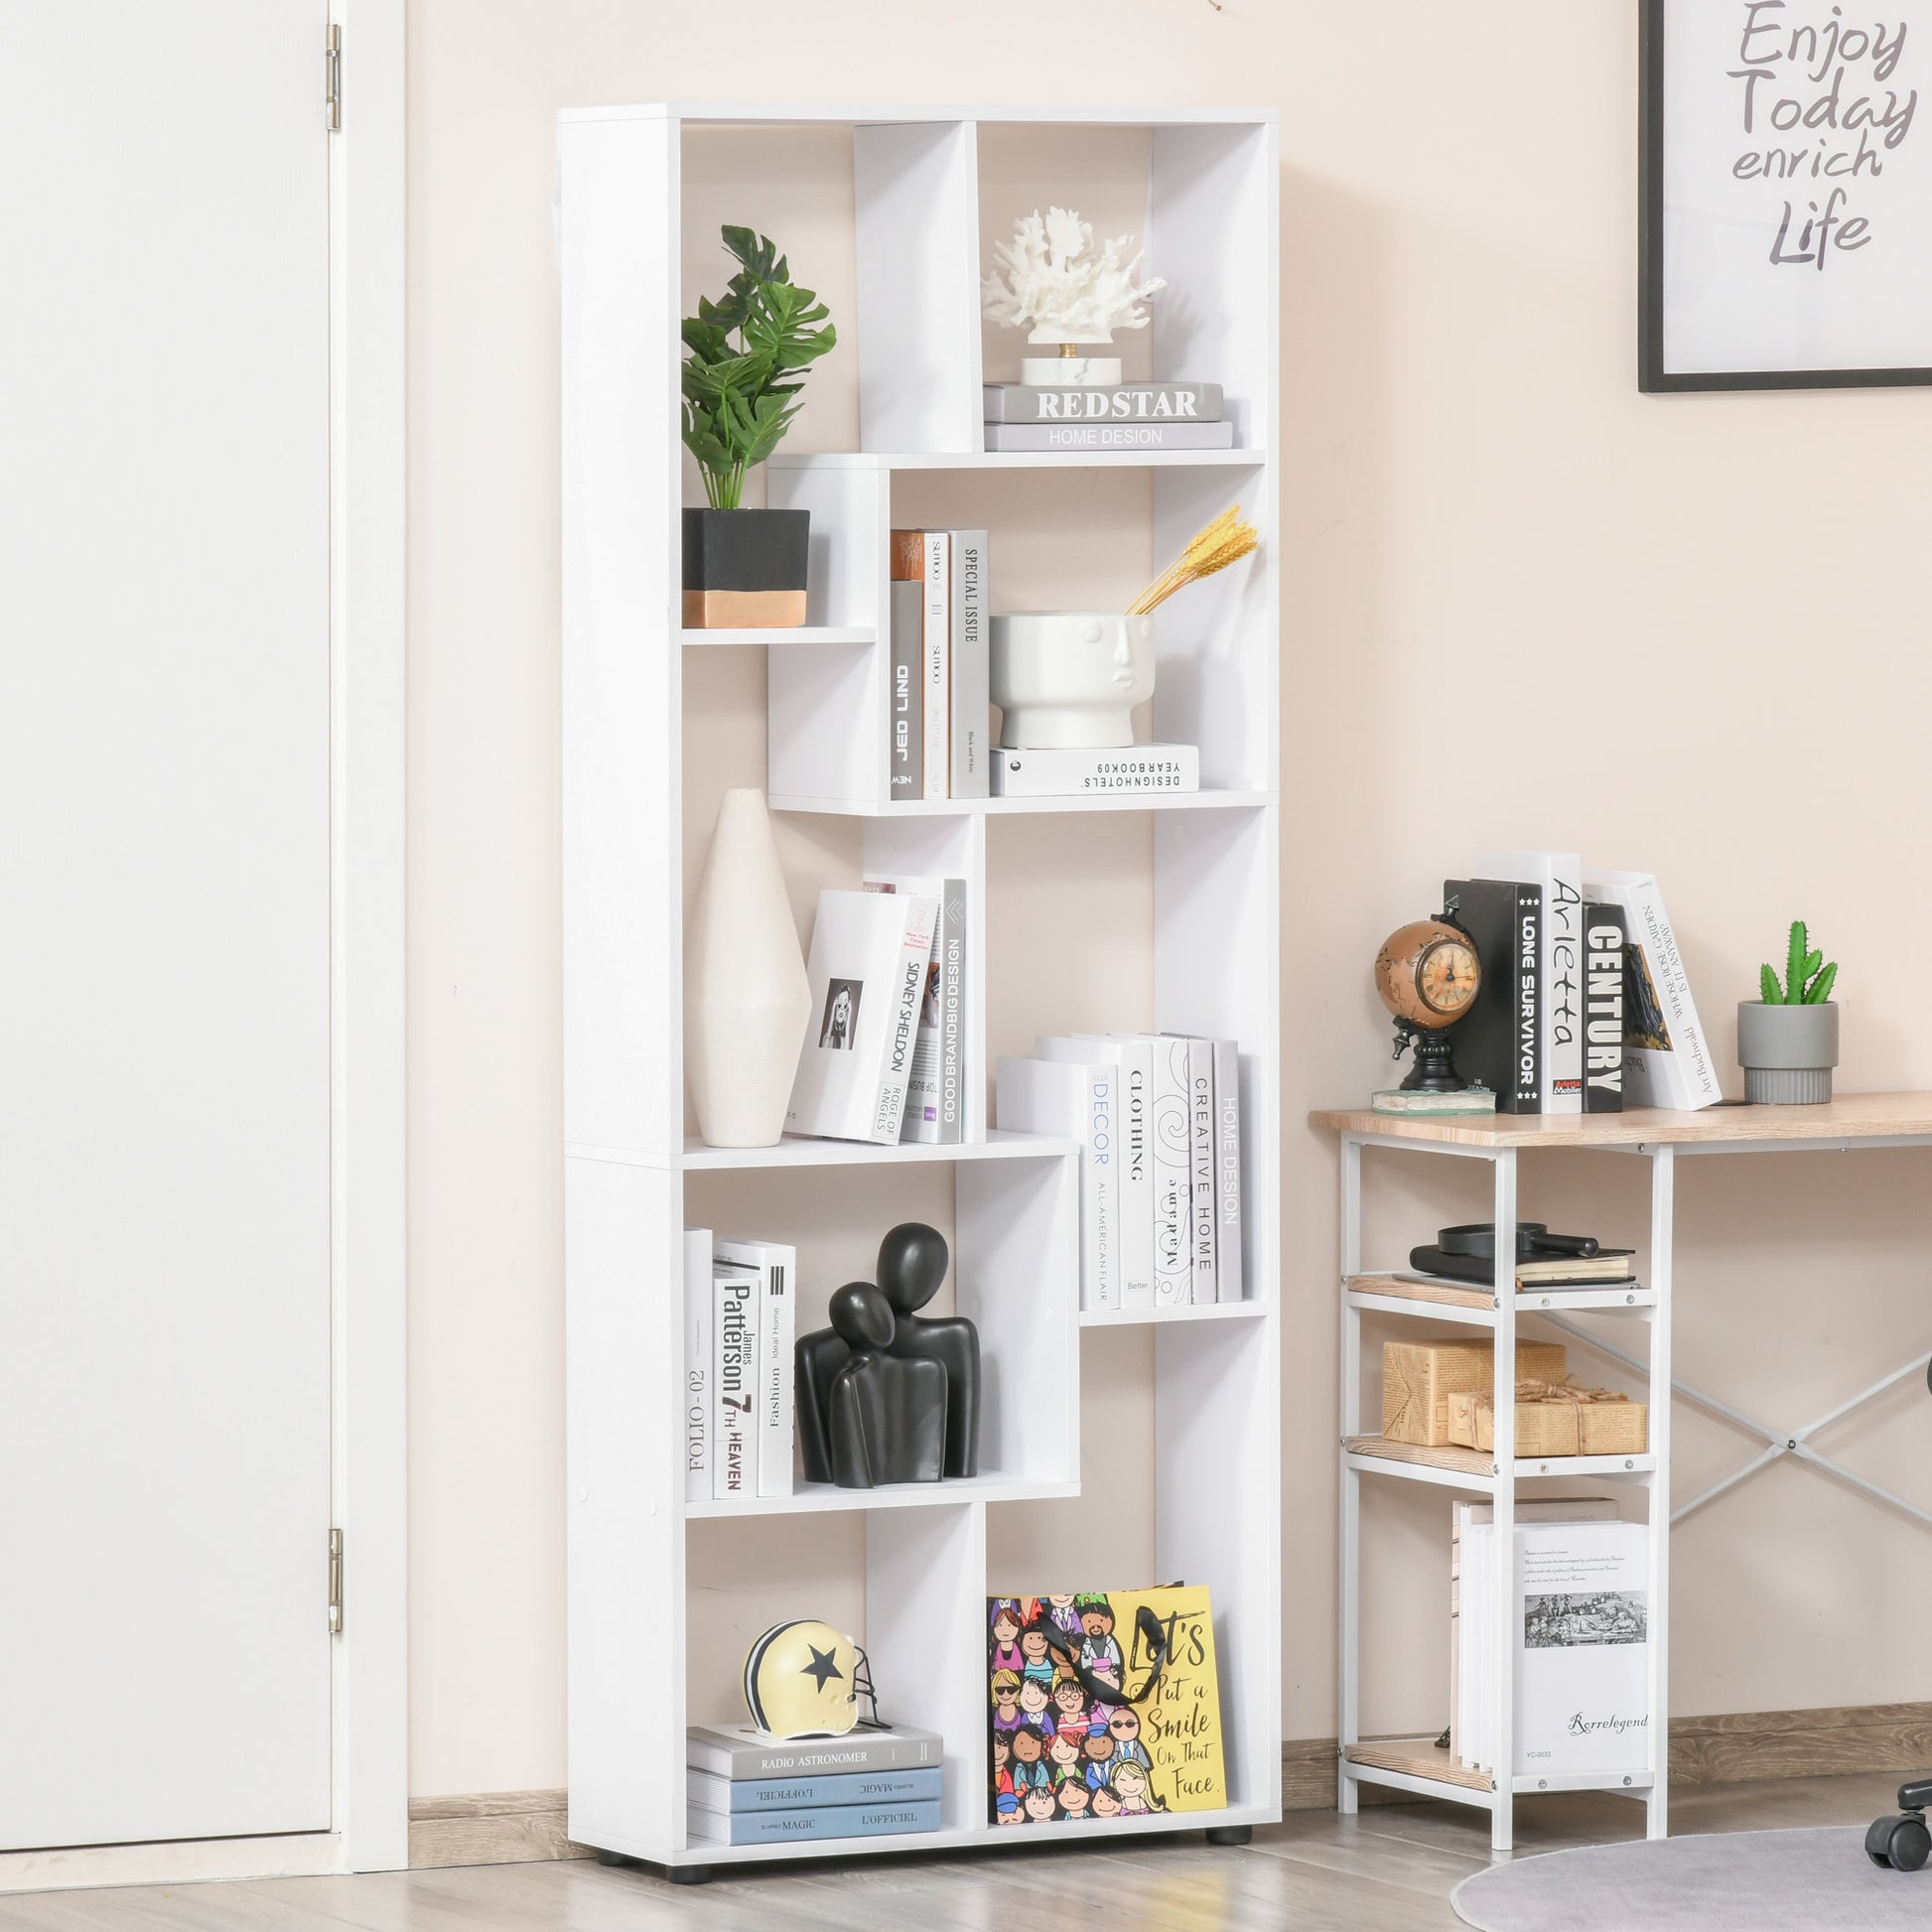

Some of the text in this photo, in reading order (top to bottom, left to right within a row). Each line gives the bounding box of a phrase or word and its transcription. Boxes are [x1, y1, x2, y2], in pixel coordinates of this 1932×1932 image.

[1740, 0, 1907, 82] Enjoy
[1725, 67, 1917, 150] Today
[1732, 128, 1882, 180] enrich
[1769, 187, 1871, 271] Life
[1036, 391, 1198, 419] REDSTAR
[1049, 428, 1163, 445] HOME DESIGN
[965, 548, 978, 642] SPECIAL ISSUE
[897, 665, 908, 761] JED LIND
[891, 775, 912, 784] NEW
[1642, 904, 1663, 949] GARDEN
[947, 938, 960, 995] DESIGN
[1657, 952, 1673, 978] ROSE
[1677, 982, 1688, 993] IS
[891, 961, 919, 1072] SIDNEY SHELDON
[1520, 916, 1535, 1085] LONE SURVIVOR
[1587, 925, 1623, 1092] CENTURY
[1665, 980, 1684, 1020] WHOSE
[1683, 1026, 1714, 1093] Art Buchwald
[877, 1087, 892, 1131] ANGELS
[944, 1077, 956, 1123] GOOD
[1093, 1083, 1109, 1166] DECOR
[887, 1121, 896, 1136] OF
[1130, 1070, 1144, 1181] CLOTHING
[1195, 1077, 1211, 1271] CREATIVE HOME
[1222, 1097, 1238, 1225] HOME DESIGN
[1098, 1181, 1108, 1302] ALL-AMERICAN FLAIR
[1166, 1178, 1178, 1267] Madame
[723, 1286, 750, 1392] Patterson
[743, 1330, 756, 1365] James
[689, 1370, 704, 1393] 02
[769, 1367, 780, 1428] Fashion
[689, 1406, 704, 1472] FOLIO
[728, 1432, 743, 1490] HEAVEN
[1155, 1673, 1208, 1706] Put a
[1148, 1703, 1211, 1743] Smile
[761, 1751, 869, 1770] RADIO ASTRONOMER
[1157, 1741, 1215, 1766] On That
[757, 1788, 813, 1801] L'OFFICIEL
[859, 1783, 893, 1795] MAGIC
[1172, 1766, 1219, 1799] Face.
[782, 1819, 816, 1831] MAGIC
[862, 1812, 918, 1826] L'OFFICIEL
